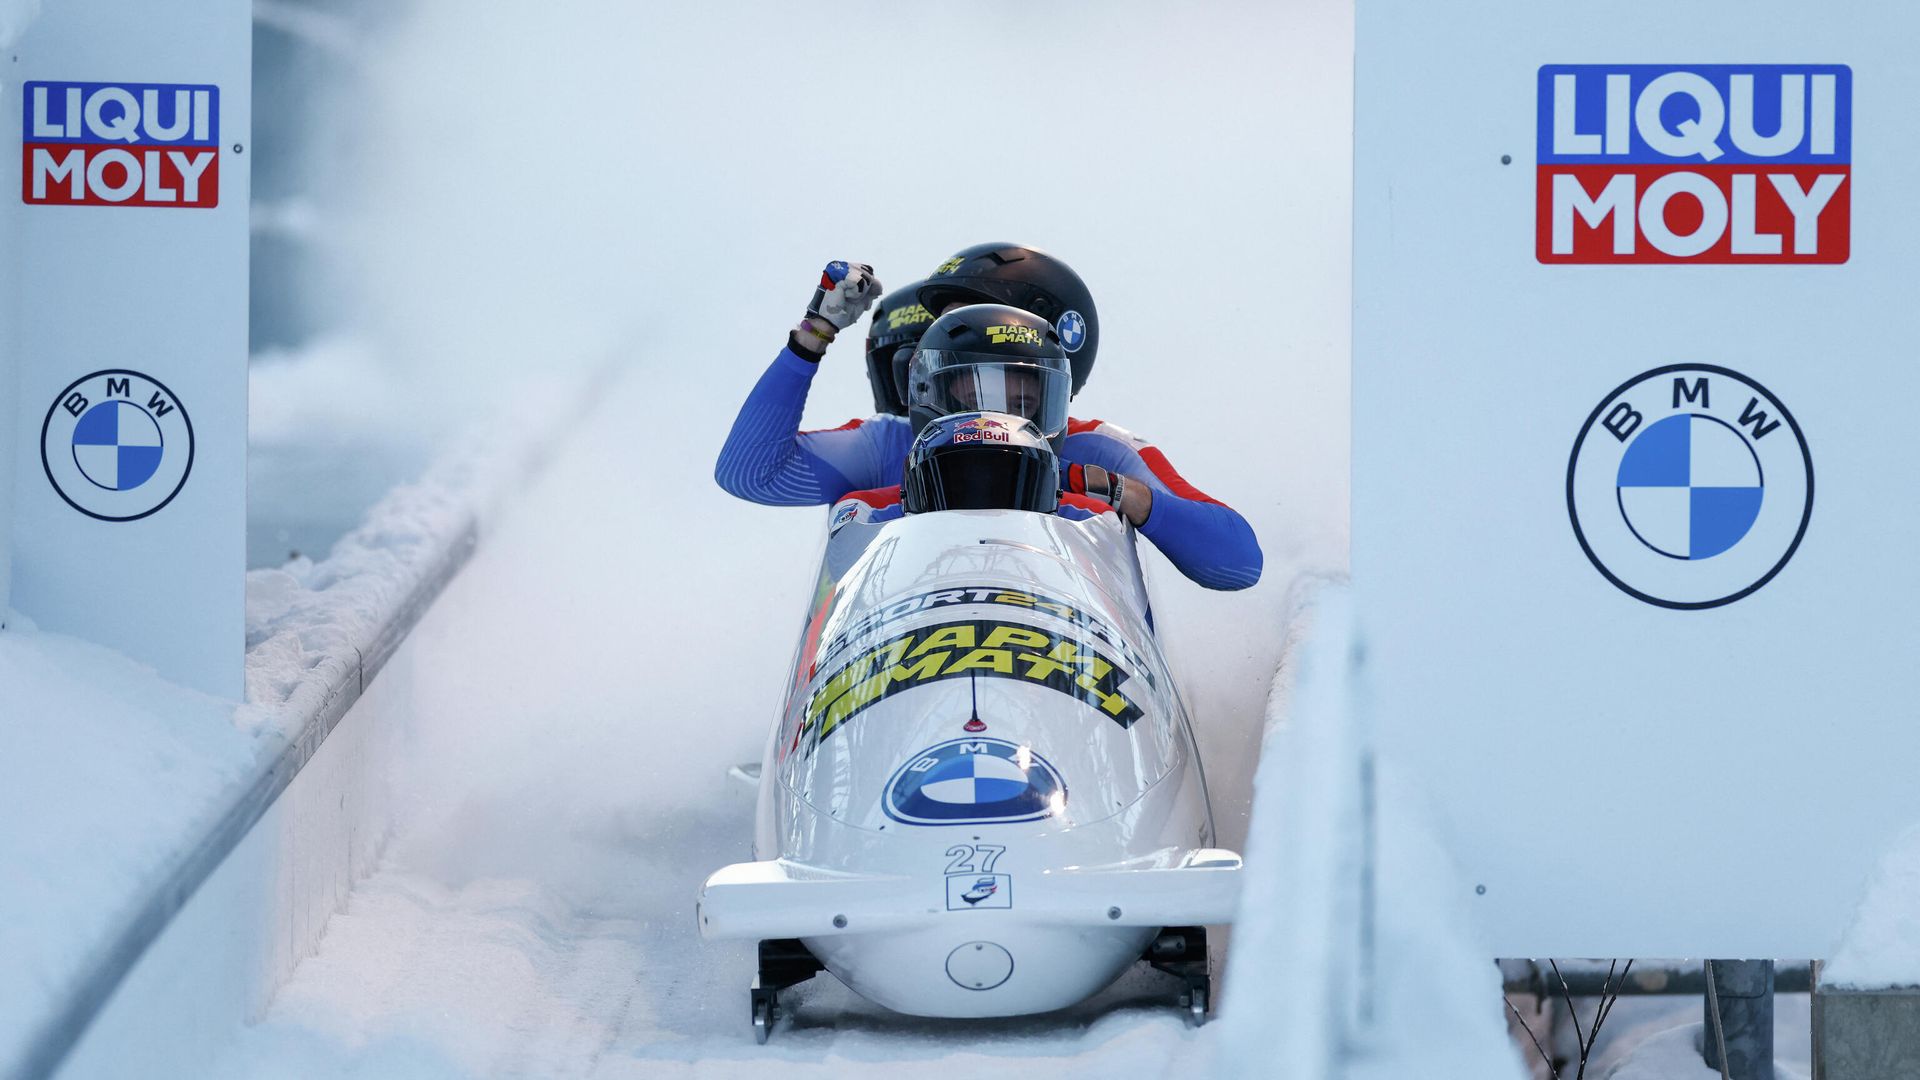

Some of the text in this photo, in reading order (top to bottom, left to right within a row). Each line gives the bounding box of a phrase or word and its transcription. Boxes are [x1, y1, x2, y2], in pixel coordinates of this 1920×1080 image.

[33, 86, 210, 143] LIQUI
[1553, 71, 1836, 162] LIQUI
[32, 148, 215, 203] MOLY
[1552, 171, 1848, 257] MOLY
[888, 304, 928, 321] ПАР
[986, 326, 1037, 336] ПАРИ
[992, 334, 1042, 347] МАТЧ
[63, 378, 174, 418] BMW
[1601, 377, 1781, 442] BMW
[954, 430, 1009, 443] Red Bull
[821, 649, 1128, 736] МАТЧ
[944, 844, 1006, 875] 27
